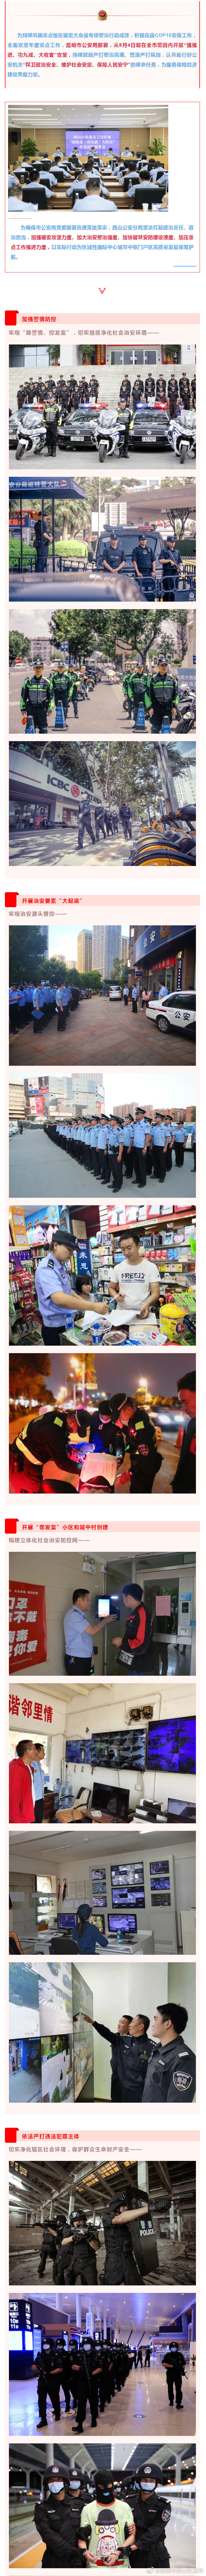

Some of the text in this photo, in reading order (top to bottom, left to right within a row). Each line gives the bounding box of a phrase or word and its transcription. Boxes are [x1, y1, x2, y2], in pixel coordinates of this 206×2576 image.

[47, 774, 69, 792] ICBC
[144, 931, 156, 948] 公安
[175, 1011, 190, 1021] 公安
[9, 1694, 53, 1723] 谐邻里情
[140, 2221, 152, 2229] 警察
